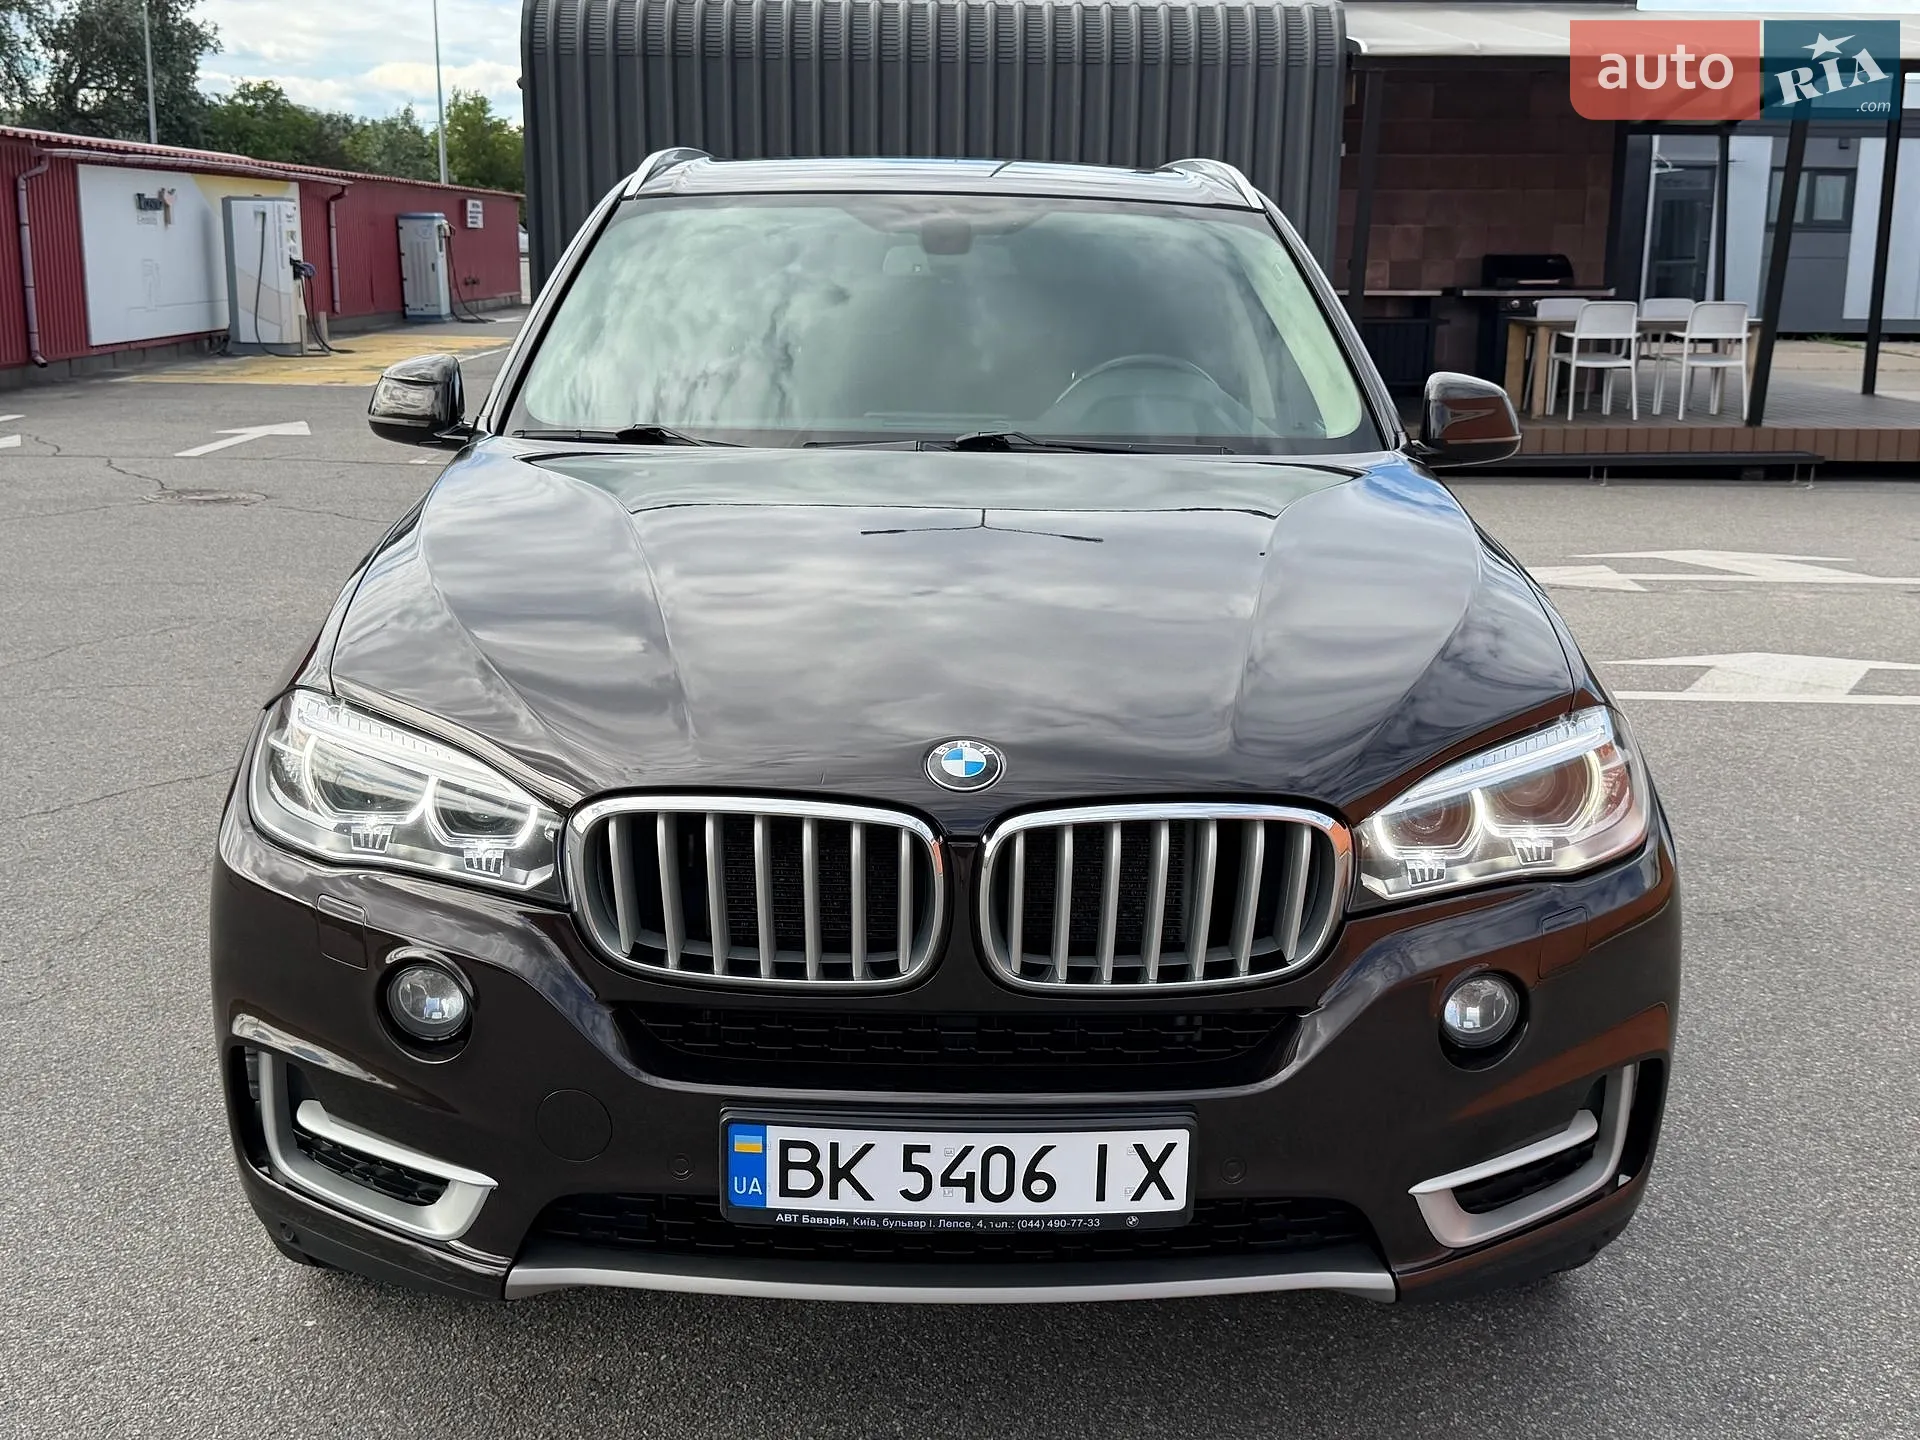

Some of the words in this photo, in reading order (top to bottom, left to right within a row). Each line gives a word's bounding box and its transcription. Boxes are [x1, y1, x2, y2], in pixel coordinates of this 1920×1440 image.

[934, 741, 994, 756] BMW
[778, 1138, 876, 1202] BK
[899, 1143, 1057, 1204] 5406
[1095, 1142, 1178, 1203] IX
[734, 1176, 763, 1196] UA
[776, 1213, 800, 1223] АВТ
[802, 1214, 849, 1227] Баварія,
[853, 1216, 879, 1228] Київ,
[882, 1217, 926, 1229] бульвар
[938, 1219, 974, 1229] Лепсе,
[976, 1219, 987, 1229] 4,
[1017, 1218, 1045, 1230] (044)
[1047, 1218, 1100, 1229] 490-77-33
